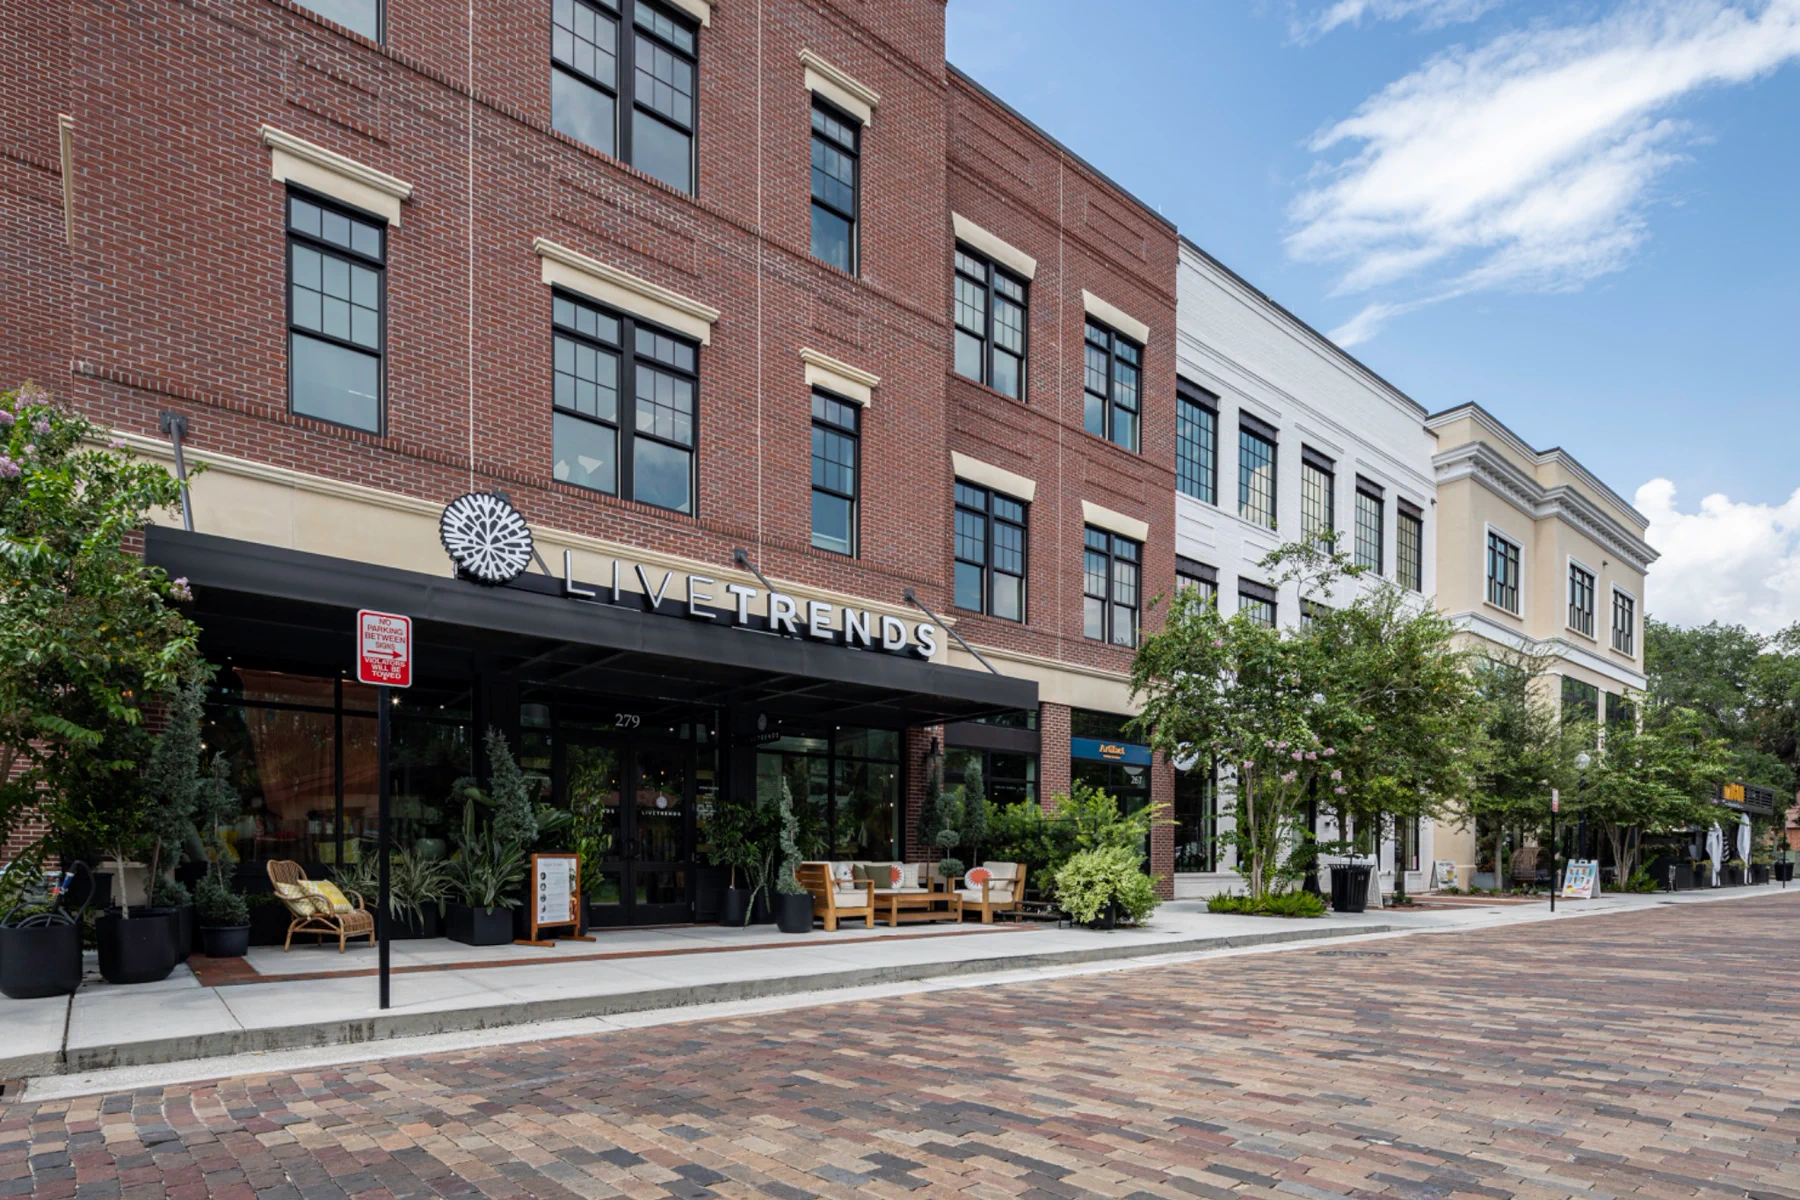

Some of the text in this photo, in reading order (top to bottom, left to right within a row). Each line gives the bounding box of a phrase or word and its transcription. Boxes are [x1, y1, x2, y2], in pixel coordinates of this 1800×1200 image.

[564, 548, 937, 661] LIVETRENDS
[379, 618, 391, 626] NO
[367, 624, 403, 636] PARKING
[365, 632, 406, 644] BETWEEN
[375, 641, 396, 650] SIGNS
[364, 656, 406, 667] VIOLATORS
[371, 664, 388, 672] WILL
[372, 670, 401, 679] TOWED
[615, 713, 640, 728] 279
[1130, 775, 1143, 784] 267
